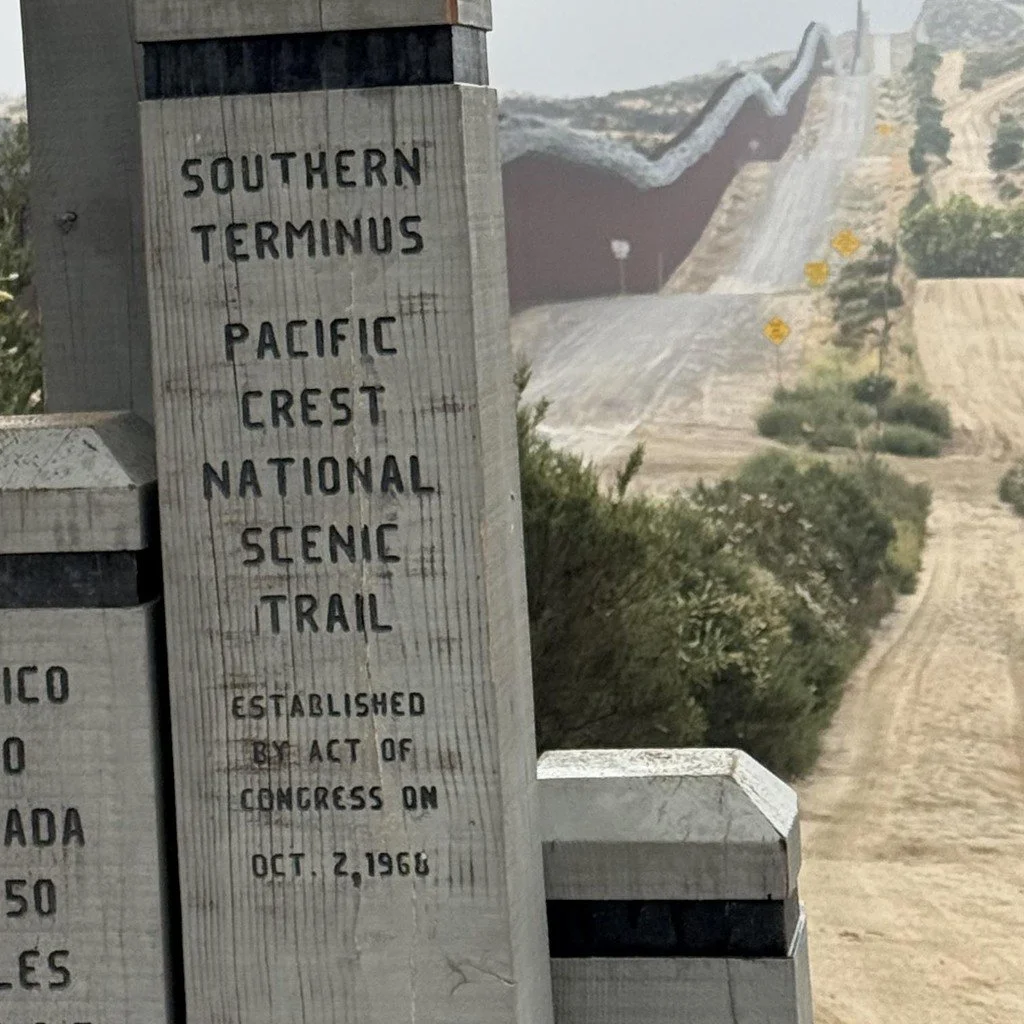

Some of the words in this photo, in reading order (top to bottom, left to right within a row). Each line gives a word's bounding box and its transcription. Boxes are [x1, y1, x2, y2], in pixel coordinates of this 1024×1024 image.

[180, 147, 422, 198] SOUTHERN
[191, 215, 424, 264] TERMINUS
[225, 316, 397, 361] PACIFIC
[242, 385, 385, 430] CREST
[203, 455, 435, 499] NATIONAL
[241, 524, 401, 566] SCENIC
[260, 593, 392, 633] TRAIL
[232, 692, 426, 719] ESTABLISHED
[252, 740, 287, 764] BY
[309, 739, 360, 763] ACT
[382, 738, 413, 762] OF
[241, 787, 383, 811] CONGRESS
[403, 785, 438, 809] ON
[251, 852, 317, 878] OCT.
